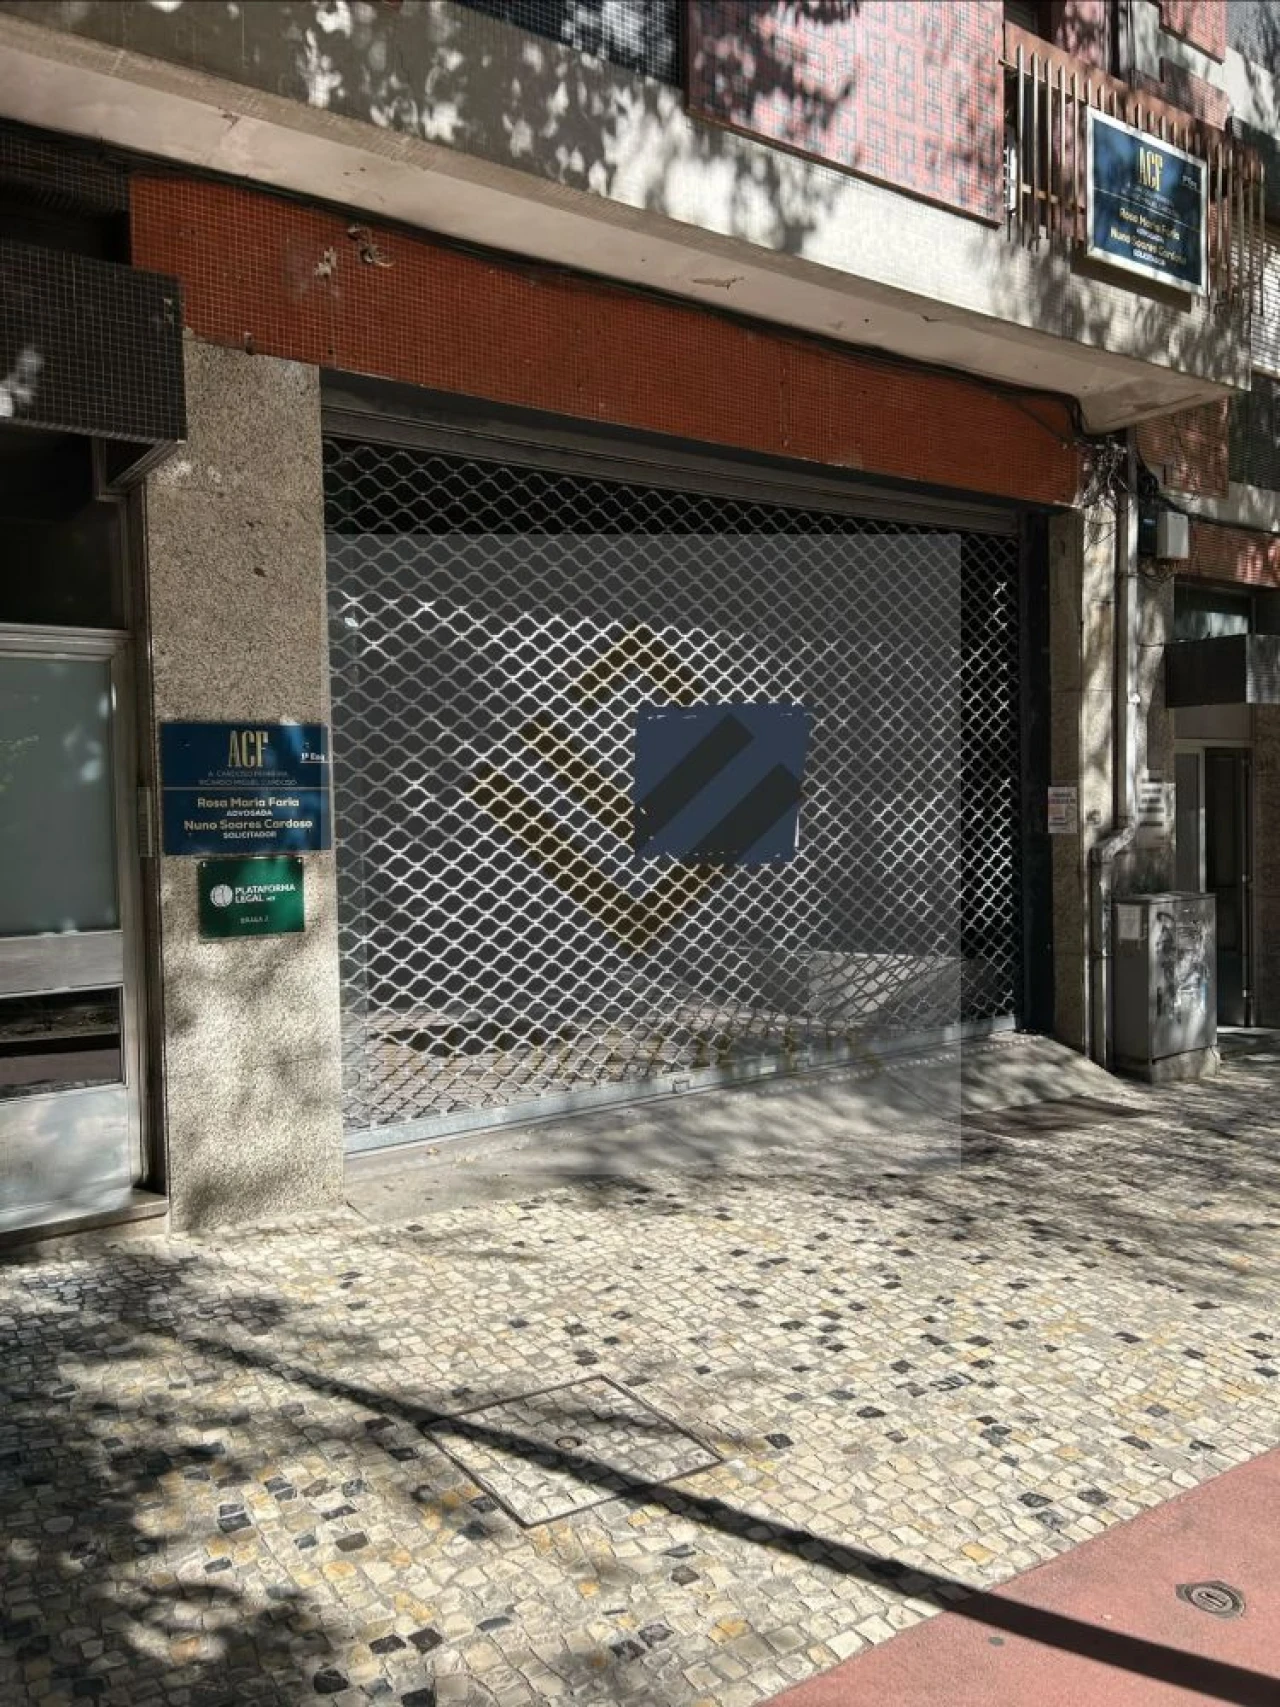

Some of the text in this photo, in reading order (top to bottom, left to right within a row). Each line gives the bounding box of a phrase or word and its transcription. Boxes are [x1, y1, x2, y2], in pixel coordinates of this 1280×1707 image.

[1137, 147, 1163, 192] ACF
[227, 730, 269, 768] ACF
[197, 797, 300, 808] Rosa Maria Faria
[183, 819, 313, 831] Nuno Soares Cardoso
[223, 831, 277, 839] SOLICITADOR
[235, 884, 296, 895] PLATAFORMA
[235, 894, 264, 904] LEGAL
